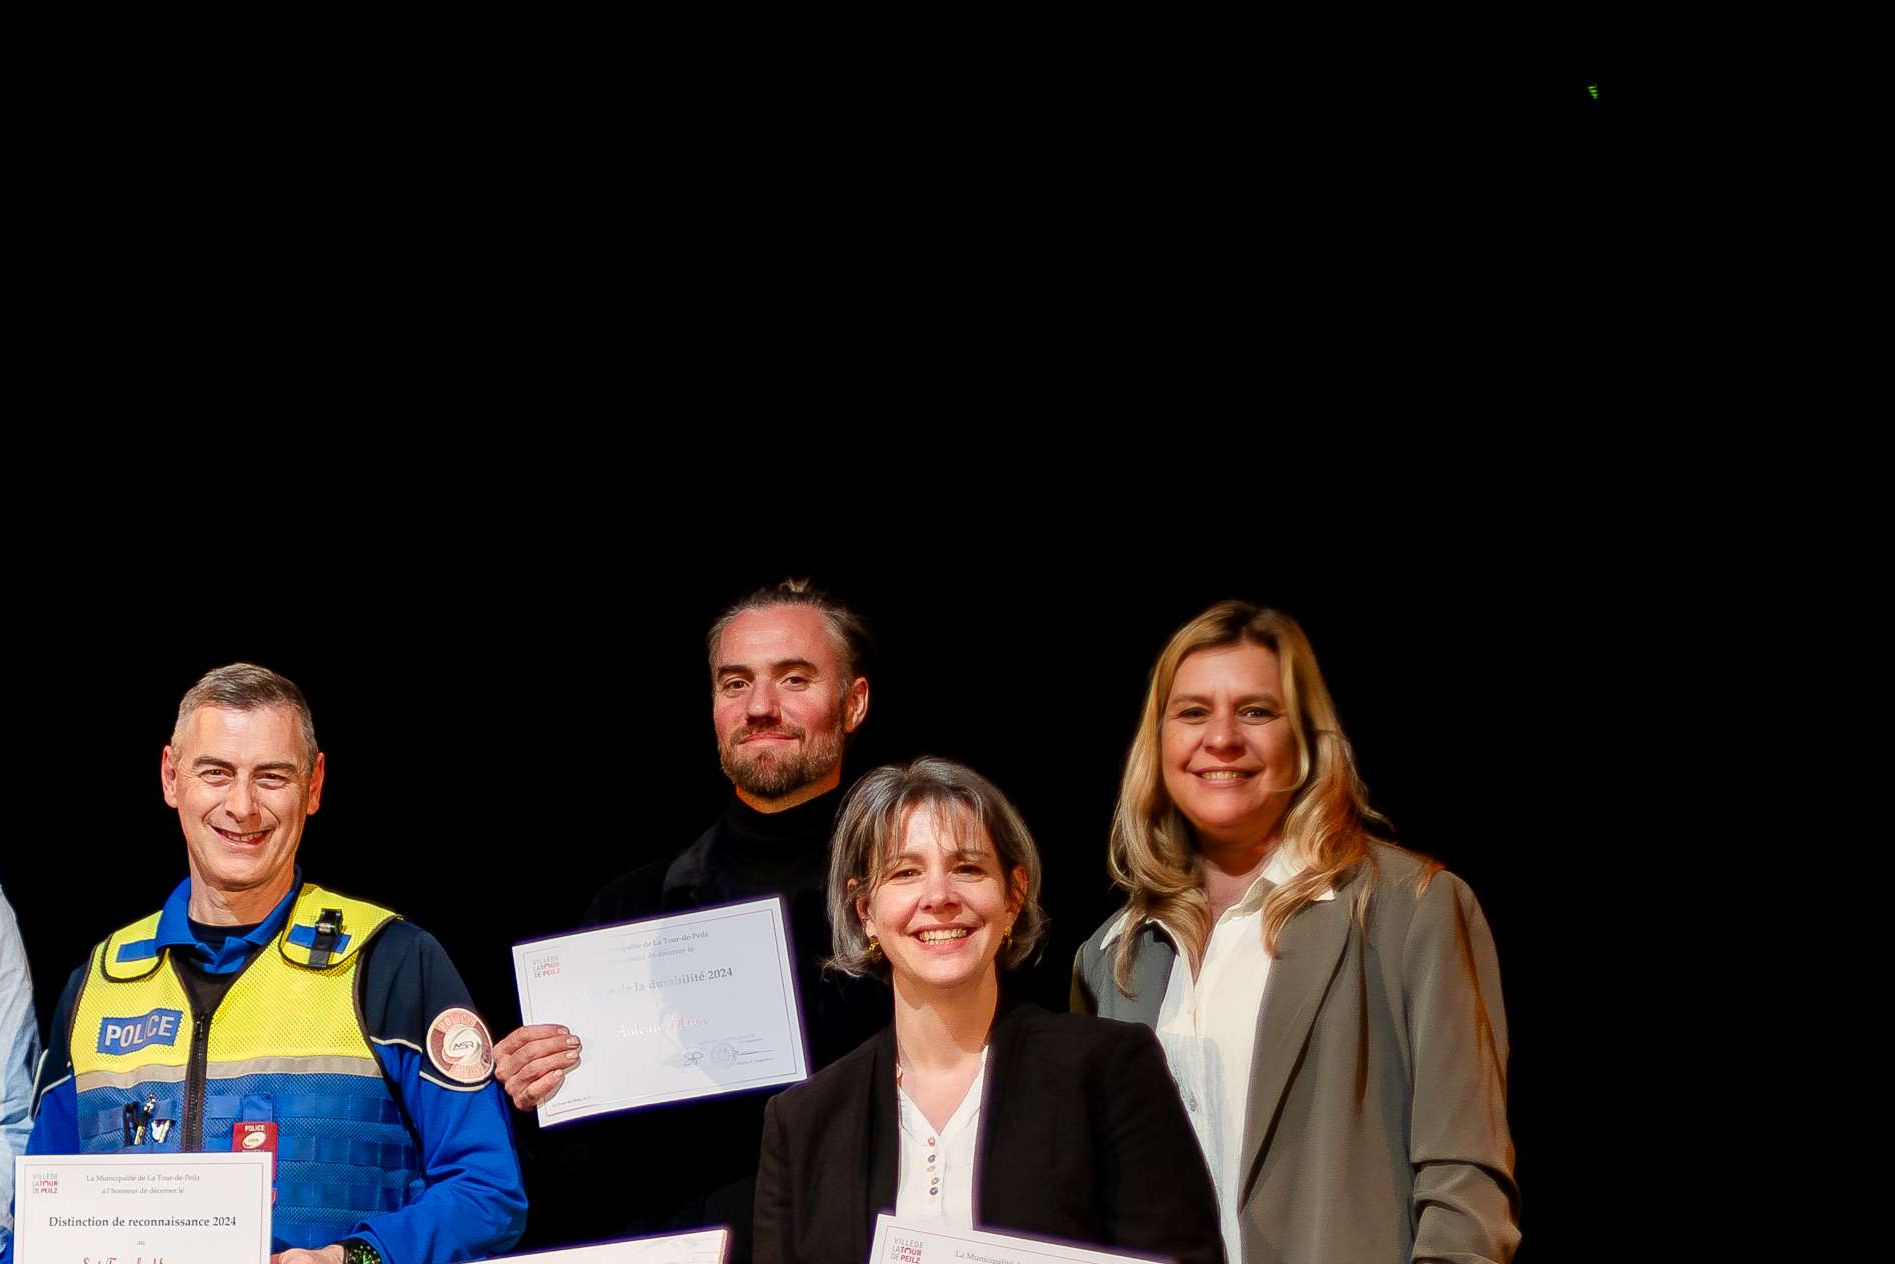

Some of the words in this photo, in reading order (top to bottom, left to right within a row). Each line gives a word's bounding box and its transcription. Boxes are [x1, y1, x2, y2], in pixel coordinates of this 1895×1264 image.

[708, 967, 733, 981] 2024
[49, 1216, 109, 1227] Distinction
[112, 1216, 125, 1227] de
[128, 1215, 210, 1227] reconnaissance
[212, 1216, 237, 1227] 2024
